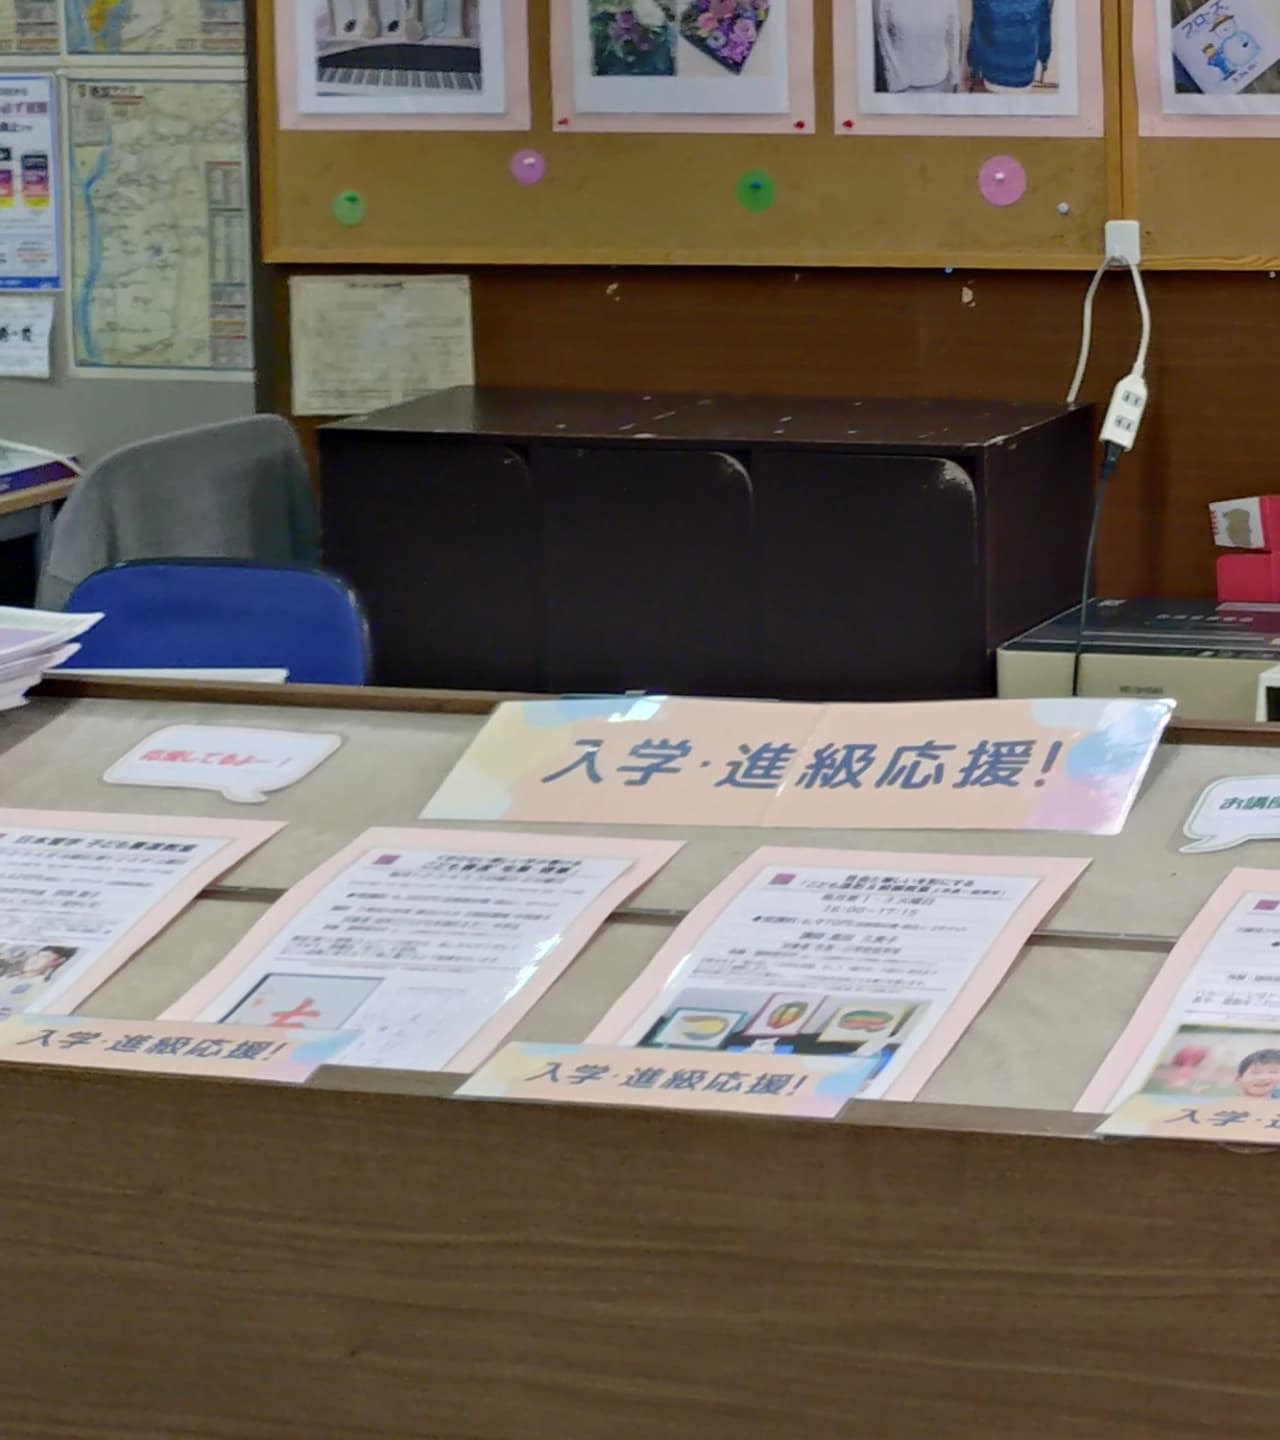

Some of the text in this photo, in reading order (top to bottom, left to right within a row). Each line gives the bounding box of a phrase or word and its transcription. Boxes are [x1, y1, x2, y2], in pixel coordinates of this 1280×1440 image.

[541, 738, 1064, 791] 入学・進級応援!
[15, 1028, 290, 1060] 入学・進級応援!
[524, 1061, 809, 1098] 入学・進級応援!
